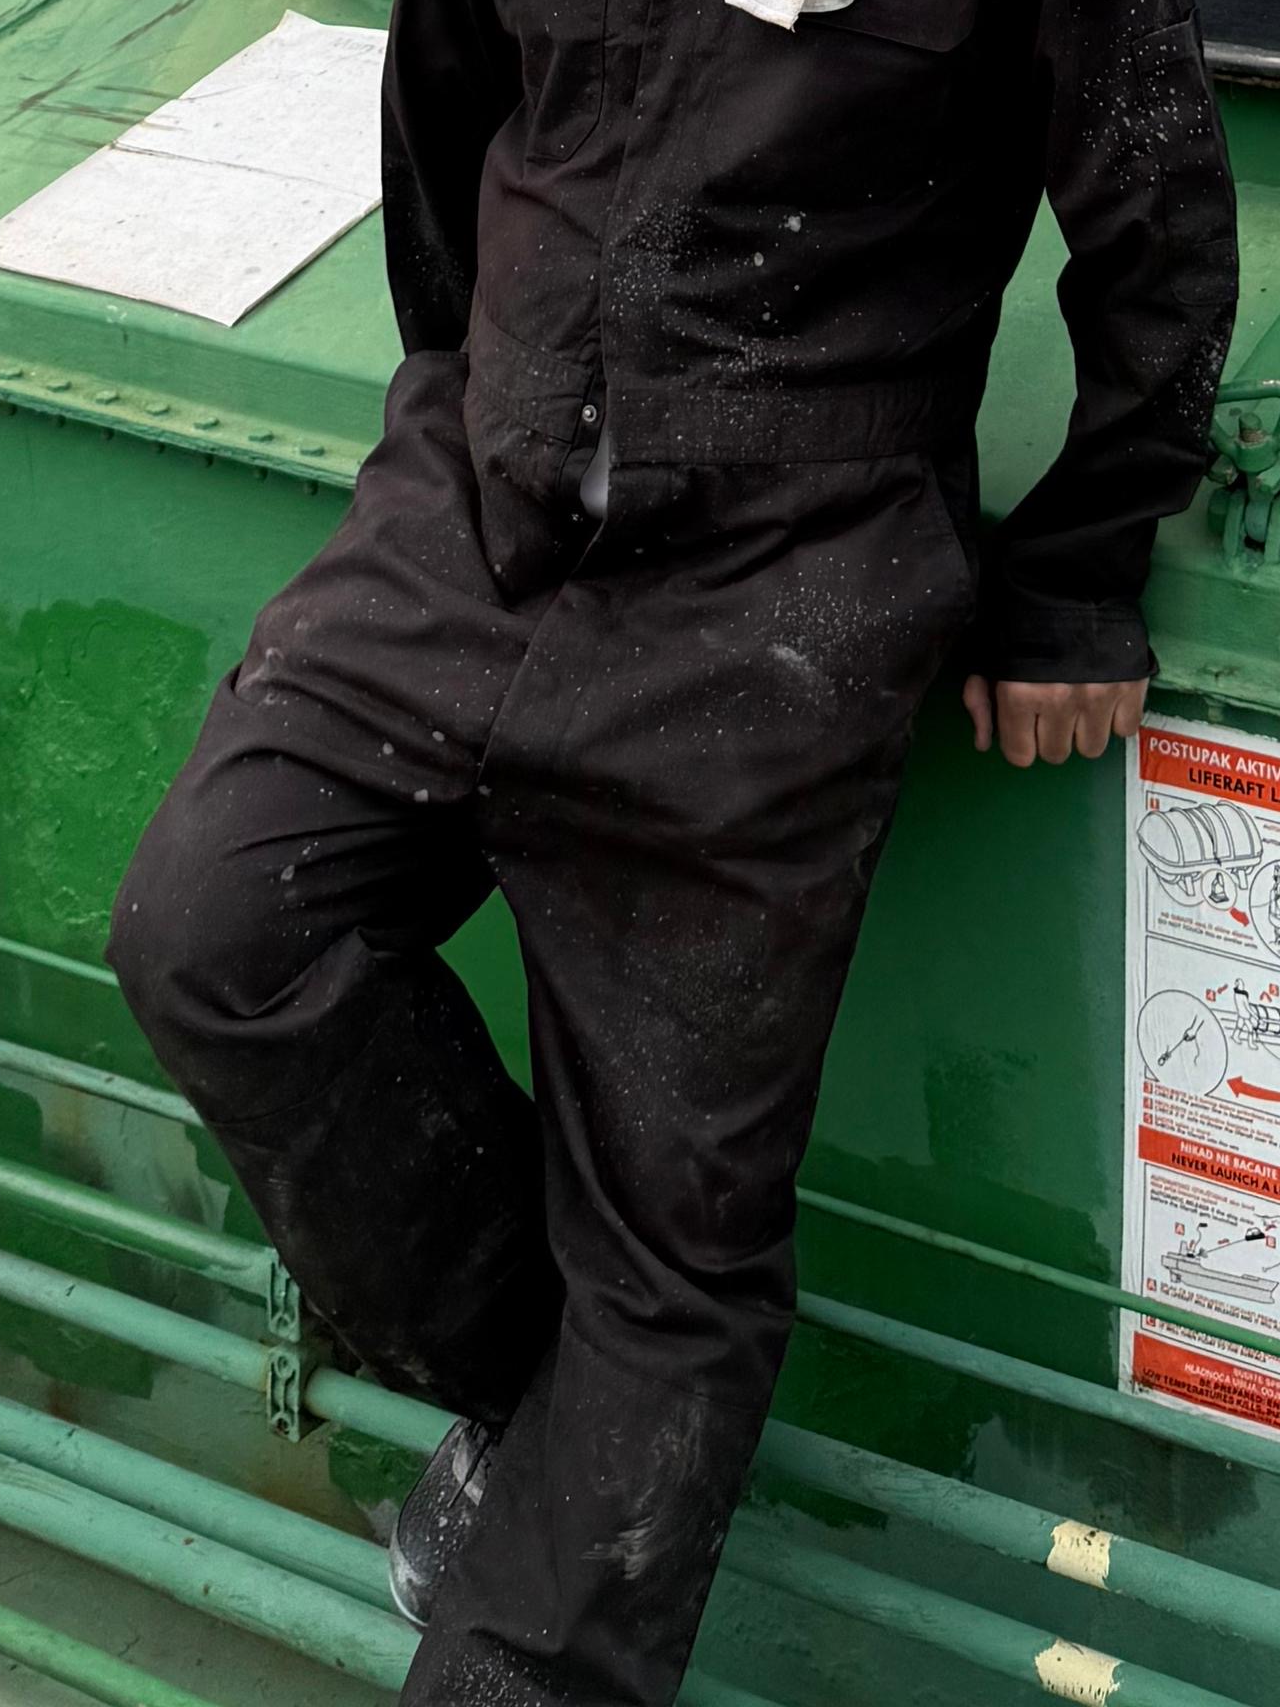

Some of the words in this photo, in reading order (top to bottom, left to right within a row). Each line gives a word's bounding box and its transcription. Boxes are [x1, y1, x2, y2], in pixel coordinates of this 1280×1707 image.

[1149, 736, 1231, 770] POSTUPAK
[1189, 766, 1264, 800] LIFERAFT
[1180, 1140, 1213, 1161] NIKAD
[1216, 1151, 1229, 1166] NE
[1171, 1151, 1207, 1173] NEVER
[1210, 1163, 1258, 1189] LAUNCH
[1261, 1178, 1270, 1192] A
